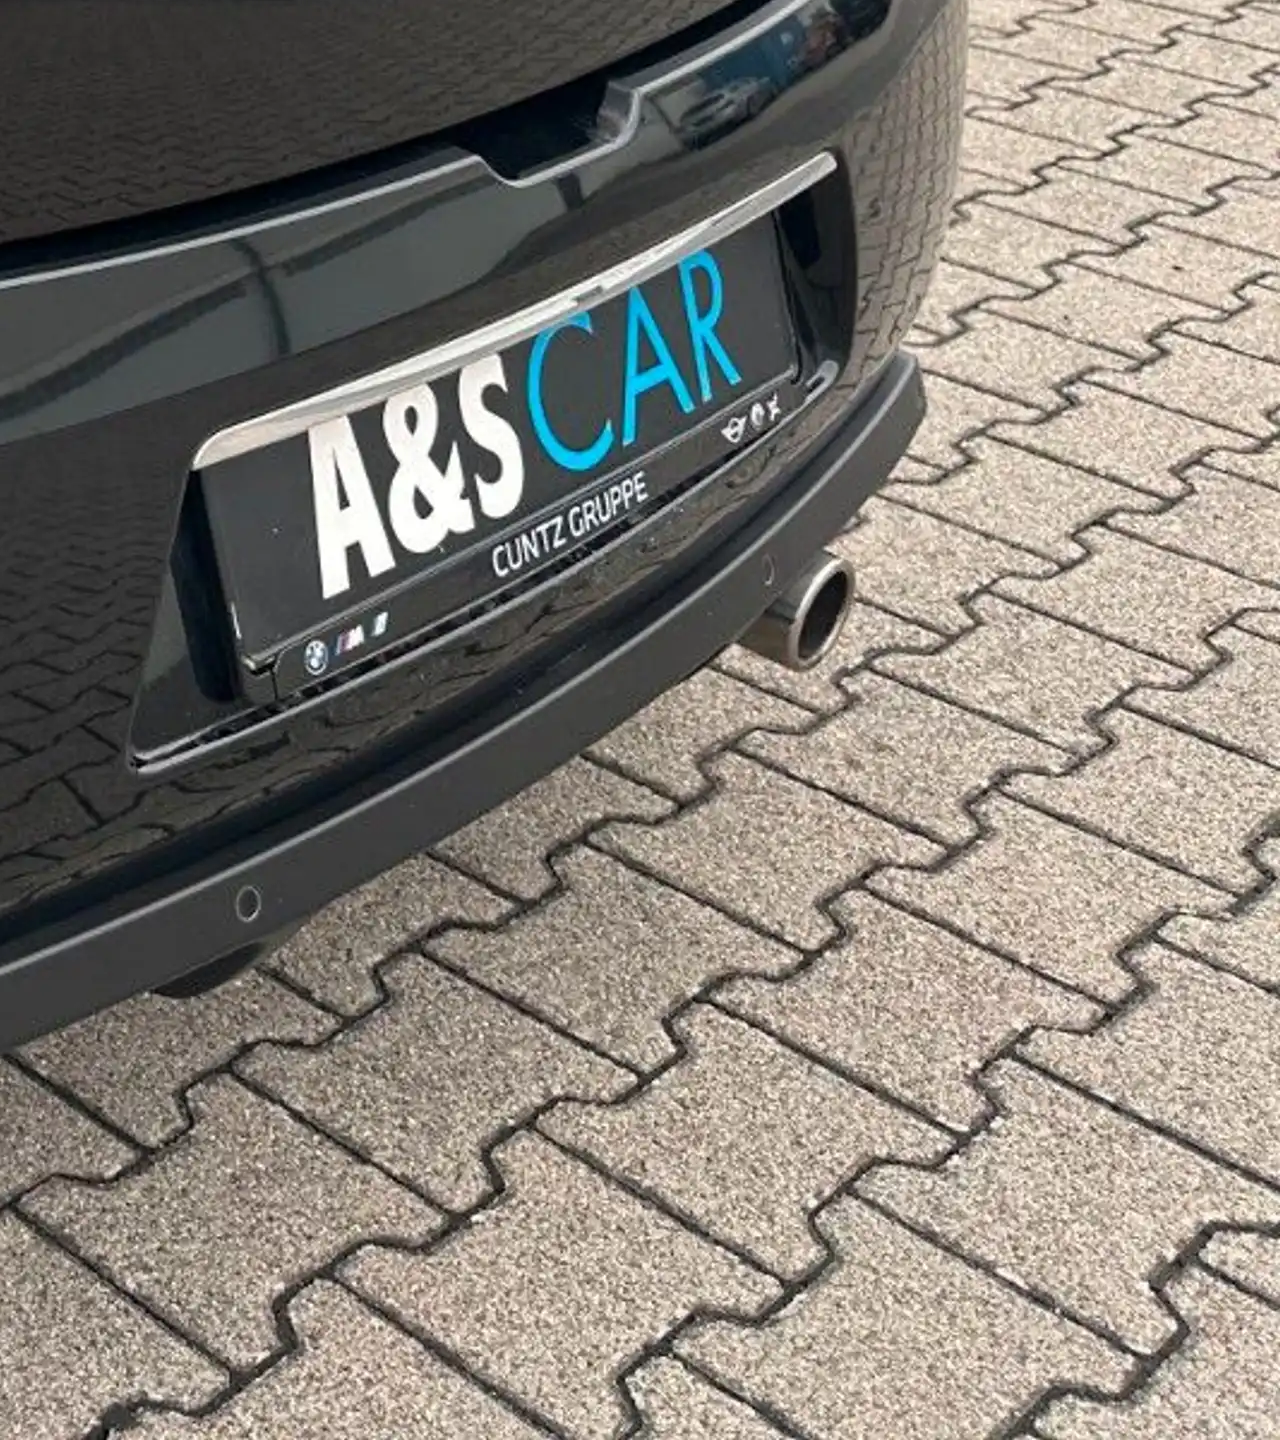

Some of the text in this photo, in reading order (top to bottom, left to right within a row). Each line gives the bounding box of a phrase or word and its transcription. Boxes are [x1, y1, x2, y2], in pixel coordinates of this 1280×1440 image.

[308, 248, 742, 600] A&S CAR
[492, 470, 649, 578] CUNTZ GRUPPE
